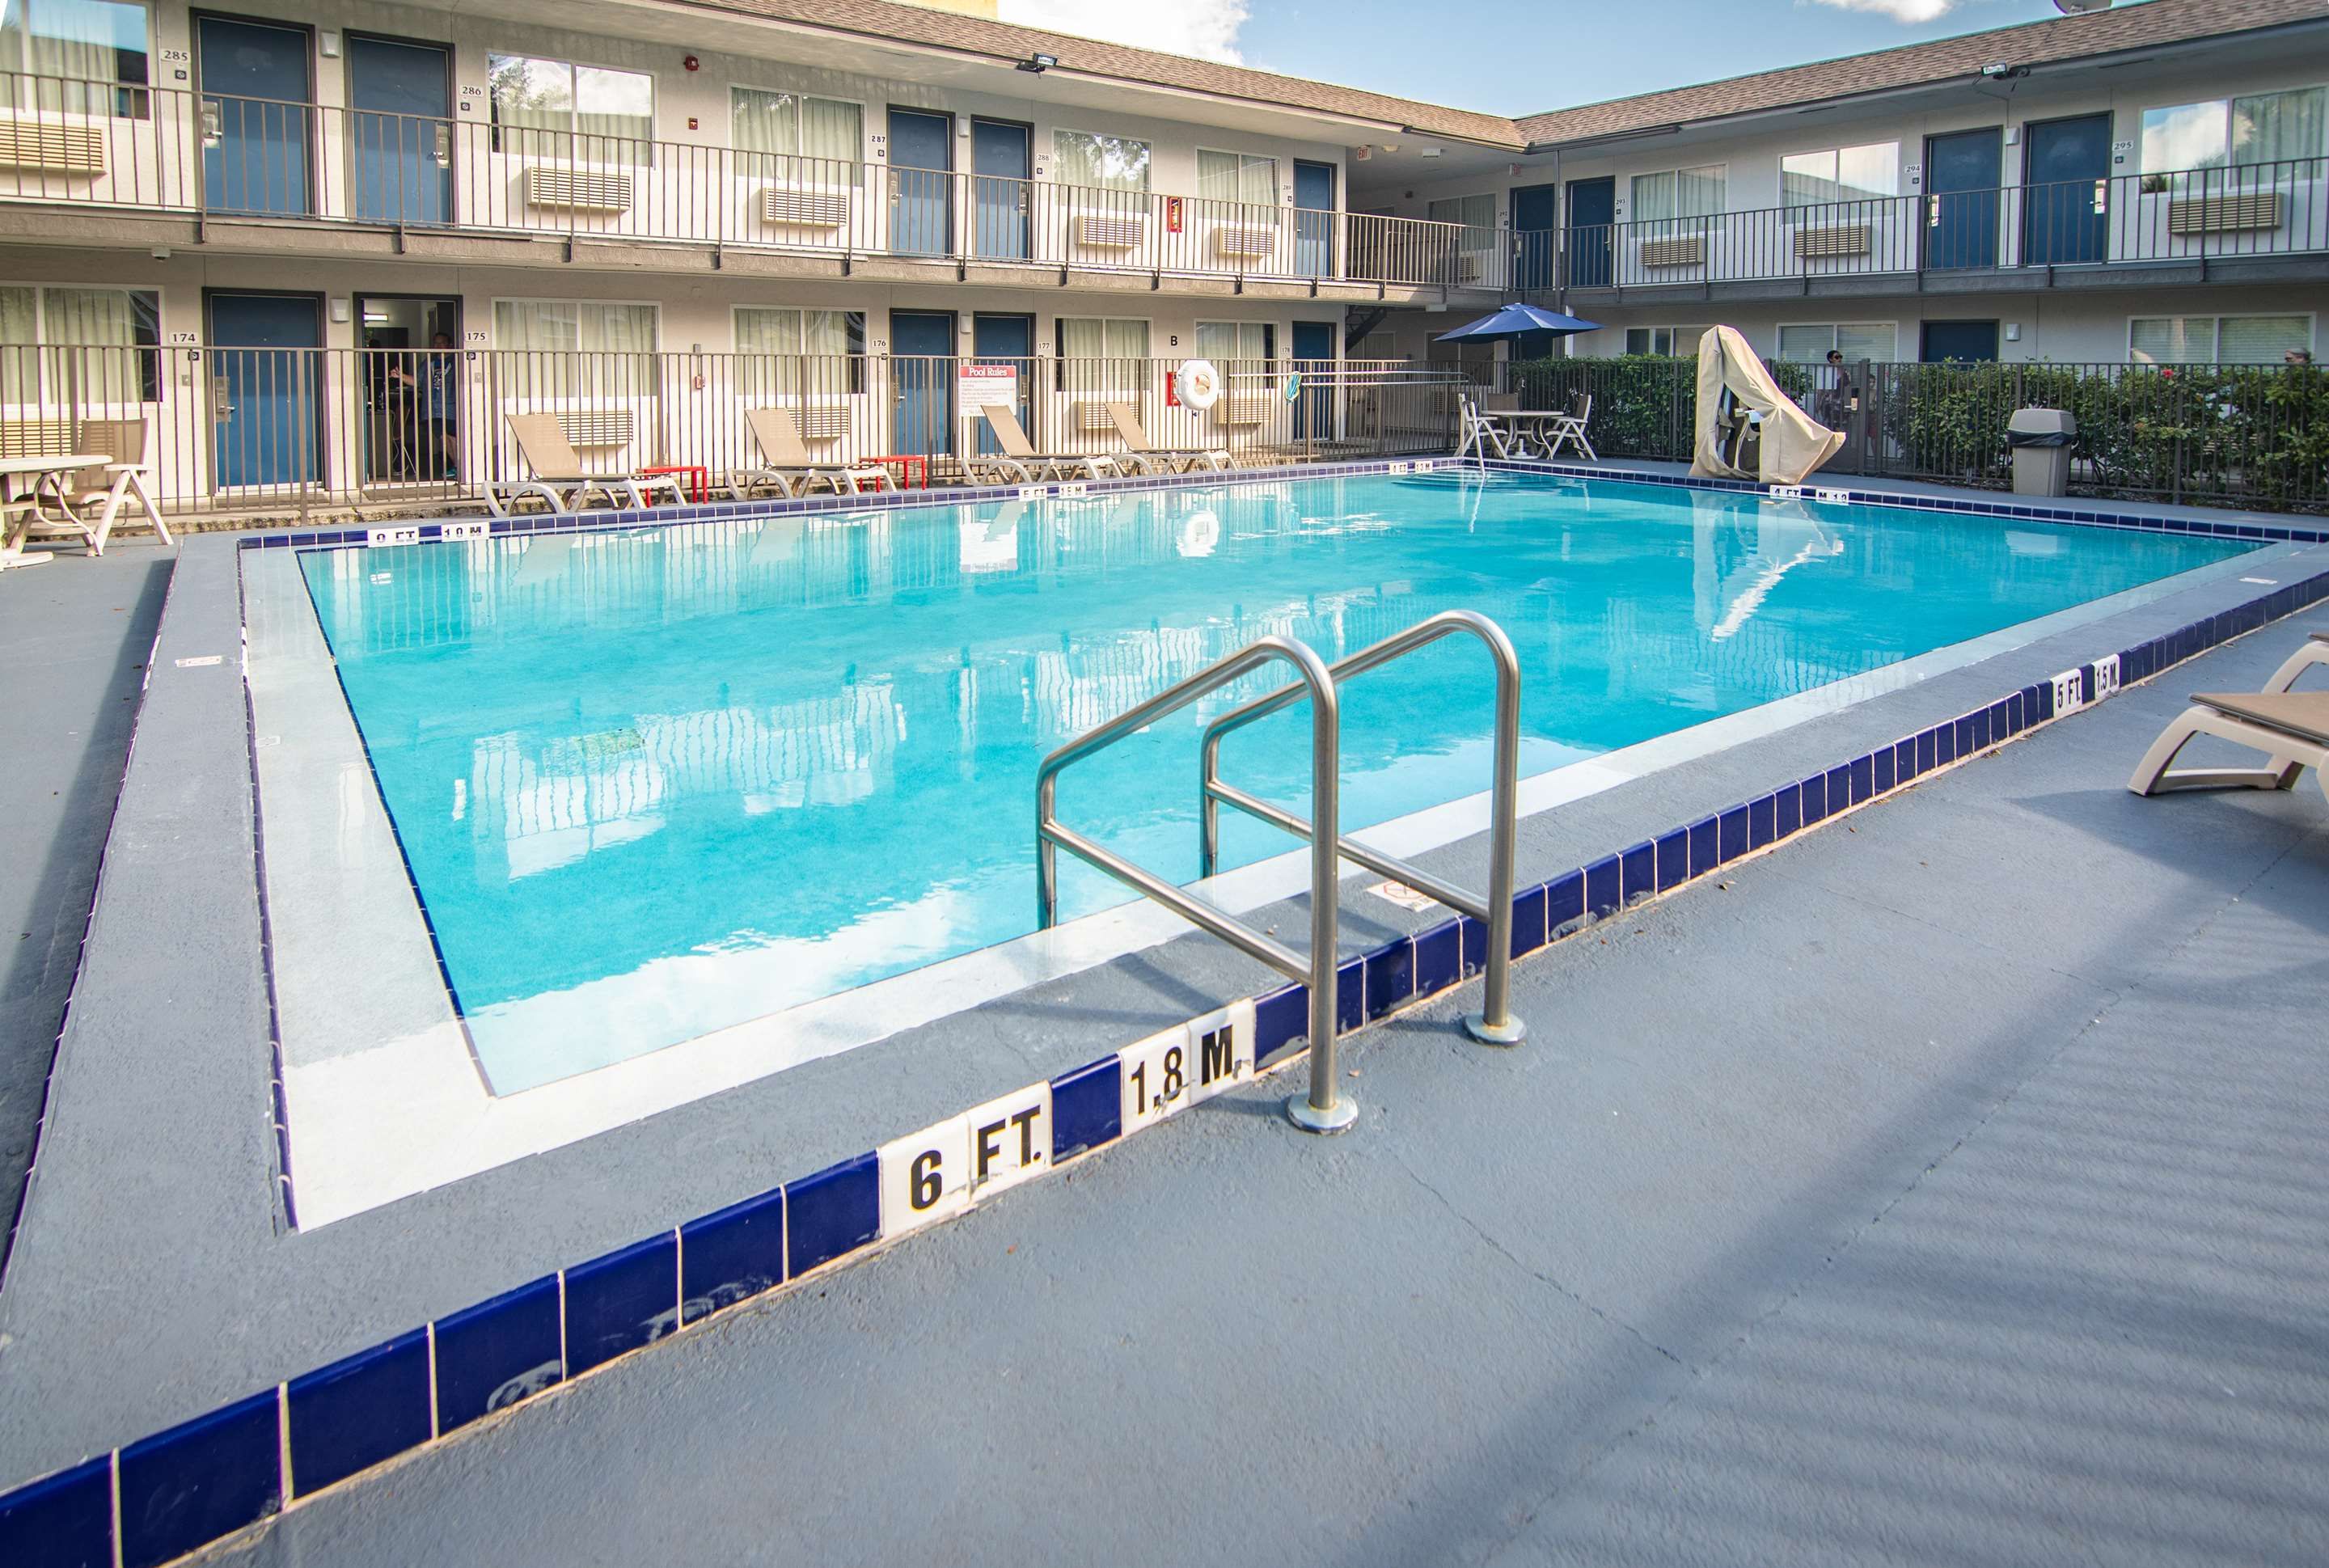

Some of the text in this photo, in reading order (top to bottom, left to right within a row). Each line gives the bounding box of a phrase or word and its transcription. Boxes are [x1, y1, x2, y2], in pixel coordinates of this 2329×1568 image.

[164, 50, 188, 61] 285
[462, 86, 482, 96] 286
[871, 135, 886, 143] 287
[2113, 142, 2132, 150] 295
[1906, 165, 1921, 173] 294
[172, 333, 197, 343] 174
[466, 332, 487, 342] 175
[1170, 335, 1178, 346] B
[873, 340, 886, 348] 176
[969, 367, 1008, 376] Pool Rules
[2057, 683, 2064, 708] 5
[911, 1149, 943, 1211] 6
[977, 1105, 1042, 1184] FT.
[1131, 1046, 1183, 1116] 1.8
